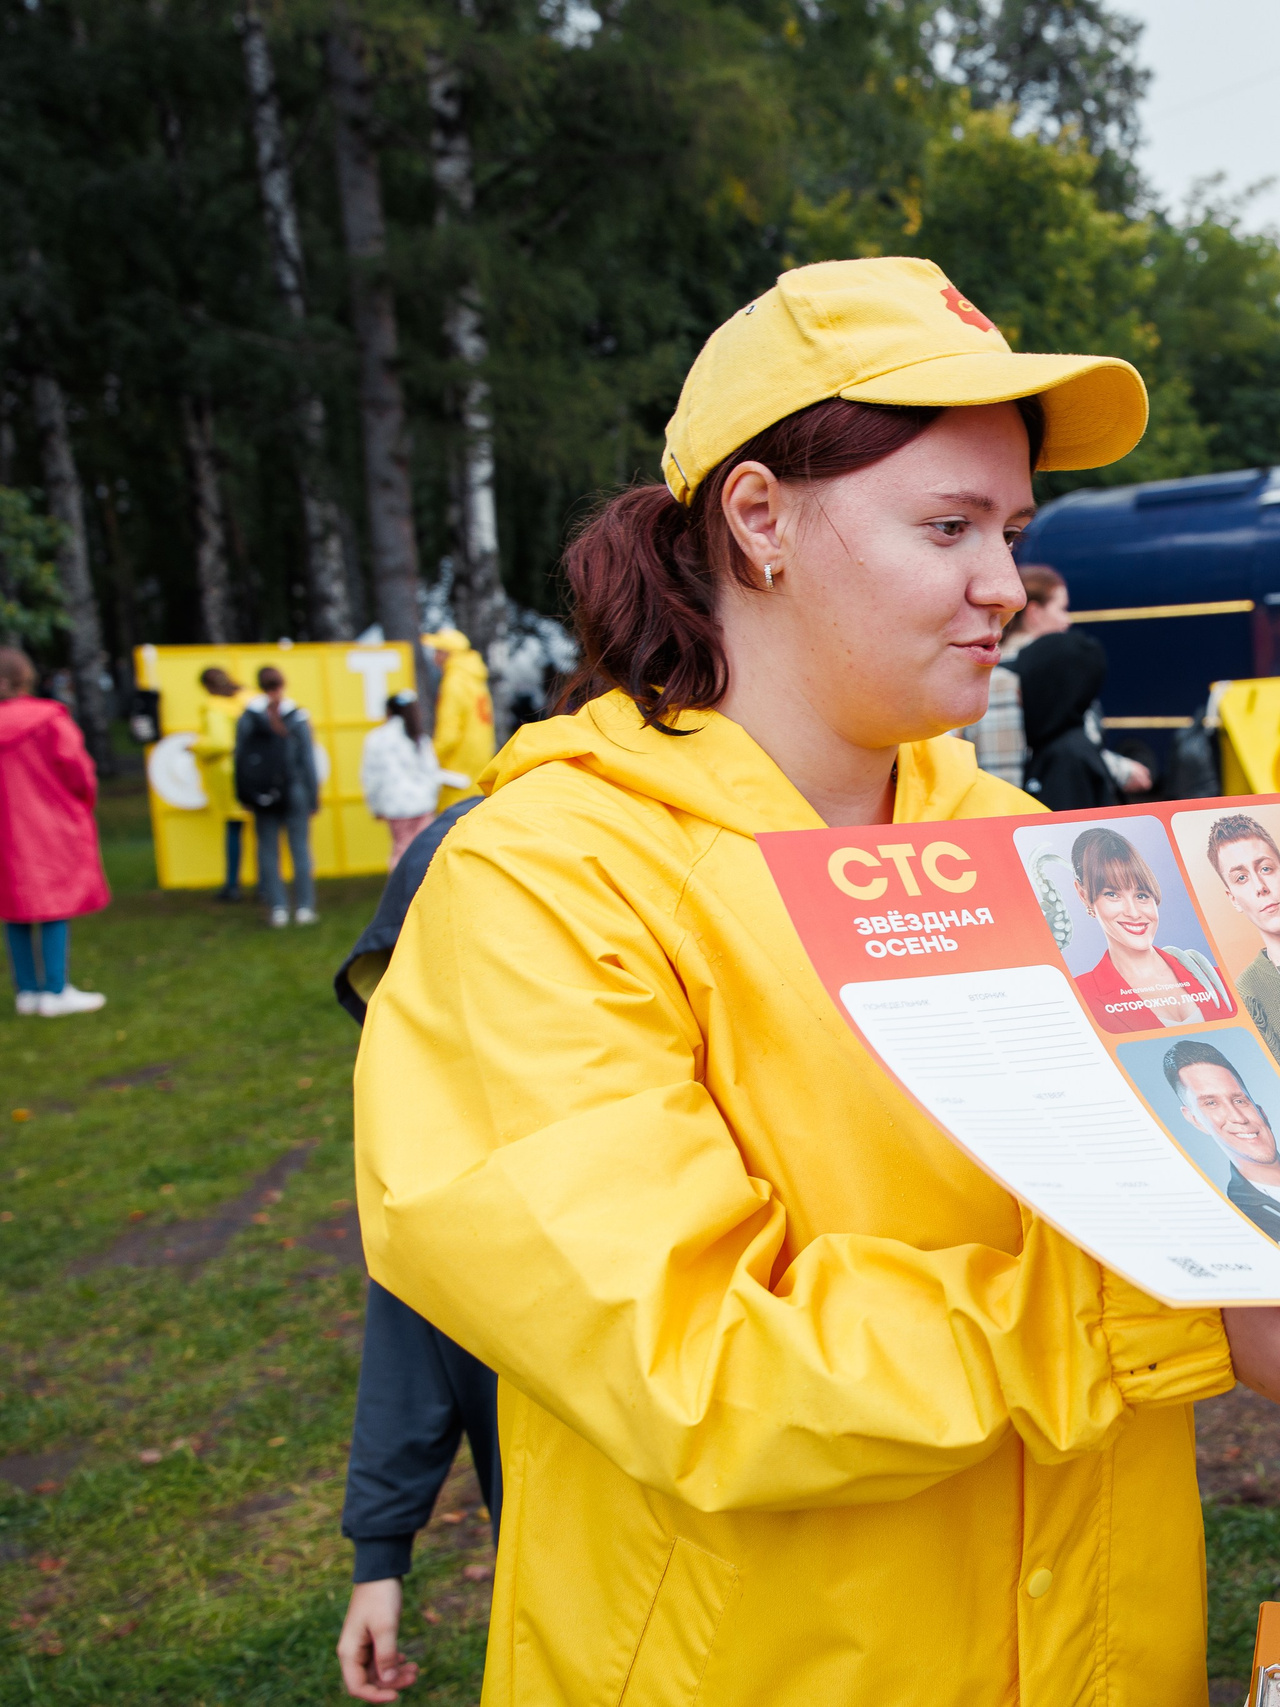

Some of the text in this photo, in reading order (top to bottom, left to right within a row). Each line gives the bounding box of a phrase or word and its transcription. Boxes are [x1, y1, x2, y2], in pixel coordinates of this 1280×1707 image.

[827, 841, 977, 901] СТС
[853, 907, 994, 936] ЗВЁЗДНАЯ
[865, 934, 958, 959] ОСЕНЬ
[968, 991, 1008, 1002] ВТОРНИК
[1120, 985, 1156, 996] Ангелина
[1105, 995, 1181, 1014] ОСТОРОЖНО,
